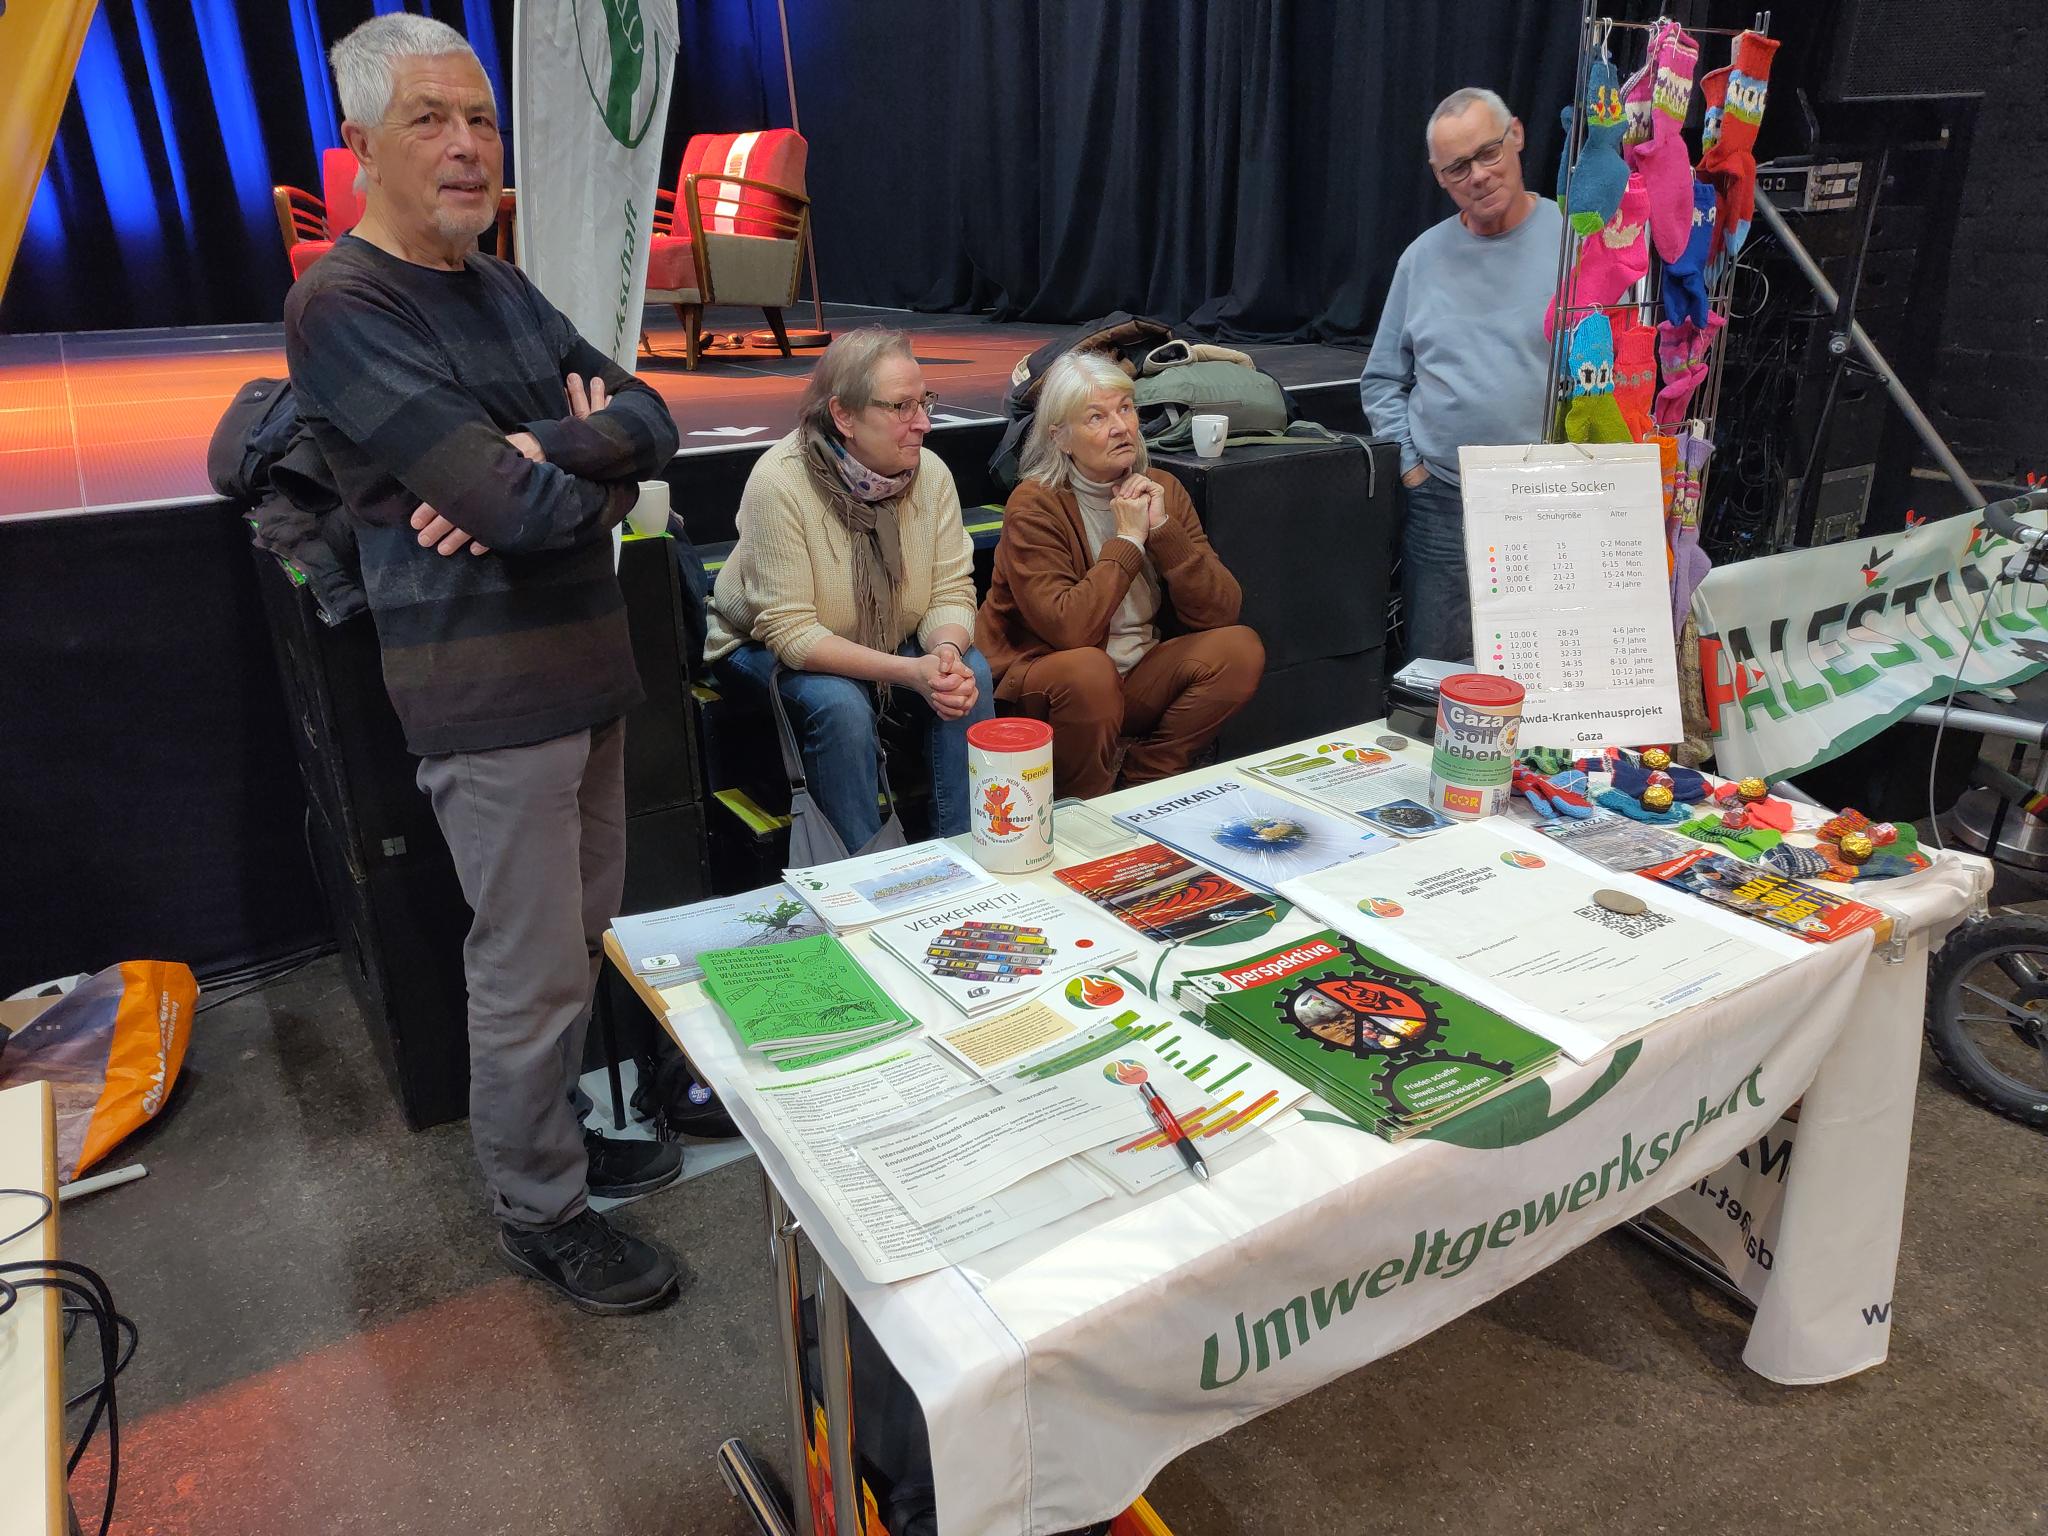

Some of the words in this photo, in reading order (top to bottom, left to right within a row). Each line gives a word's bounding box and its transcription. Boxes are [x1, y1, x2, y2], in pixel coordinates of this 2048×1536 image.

[1511, 482, 1567, 495] Preisliste
[1571, 480, 1616, 493] Socken
[1504, 514, 1523, 522] Preis
[1537, 511, 1581, 521] Schuhgröße
[1610, 510, 1627, 518] Alter
[1522, 543, 1528, 551] €
[1554, 583, 1575, 591] 24-27
[1533, 630, 1538, 638] €
[1557, 629, 1579, 637] 28-29
[1626, 626, 1646, 634] Jahre
[1627, 636, 1647, 644] Jahre
[1534, 651, 1539, 659] €
[1628, 647, 1647, 655] Jahre
[1634, 657, 1653, 665] Jahre
[1562, 670, 1584, 678] 36-37
[1635, 667, 1654, 675] Jahre
[1537, 682, 1542, 690] €
[1613, 678, 1634, 686] 13-14
[1636, 677, 1655, 686] Jahre
[1450, 706, 1504, 728] Gaza
[1454, 729, 1494, 744] soll
[1577, 732, 1603, 742] Gaza
[1445, 740, 1501, 762] leben
[1127, 782, 1241, 823] PLASTIKATLAS
[1445, 791, 1479, 808] ICOR
[1407, 887, 1427, 897] DEN
[1425, 866, 1493, 893] INTERNATIONALEN
[1421, 872, 1497, 900] UMWELTRATSCHLAG
[904, 892, 1021, 932] VERKEHR[T]!
[706, 951, 736, 960] Sand-
[712, 953, 784, 966] Extraktivismus
[730, 960, 773, 970] Altdorfer
[774, 957, 797, 966] Wald
[1230, 944, 1333, 987] perspektive
[718, 967, 774, 980] Widerstand
[776, 966, 791, 974] für
[723, 978, 744, 986] eine
[747, 972, 795, 983] Bauwende
[1403, 1078, 1432, 1091] Frieden
[1431, 1066, 1461, 1081] schaffen
[1407, 1086, 1438, 1100] Umwelt
[1436, 1079, 1459, 1091] retten
[1412, 1091, 1454, 1108] Faschismus
[1451, 1076, 1492, 1096] bekämpfen
[879, 1139, 933, 1160] Internationalen
[932, 1112, 990, 1140] Umweltratschlag
[1017, 1085, 1058, 1103] International
[885, 1145, 936, 1168] Environmental
[936, 1134, 962, 1148] Council
[1199, 1061, 1766, 1391] Umweltgewerkschft
